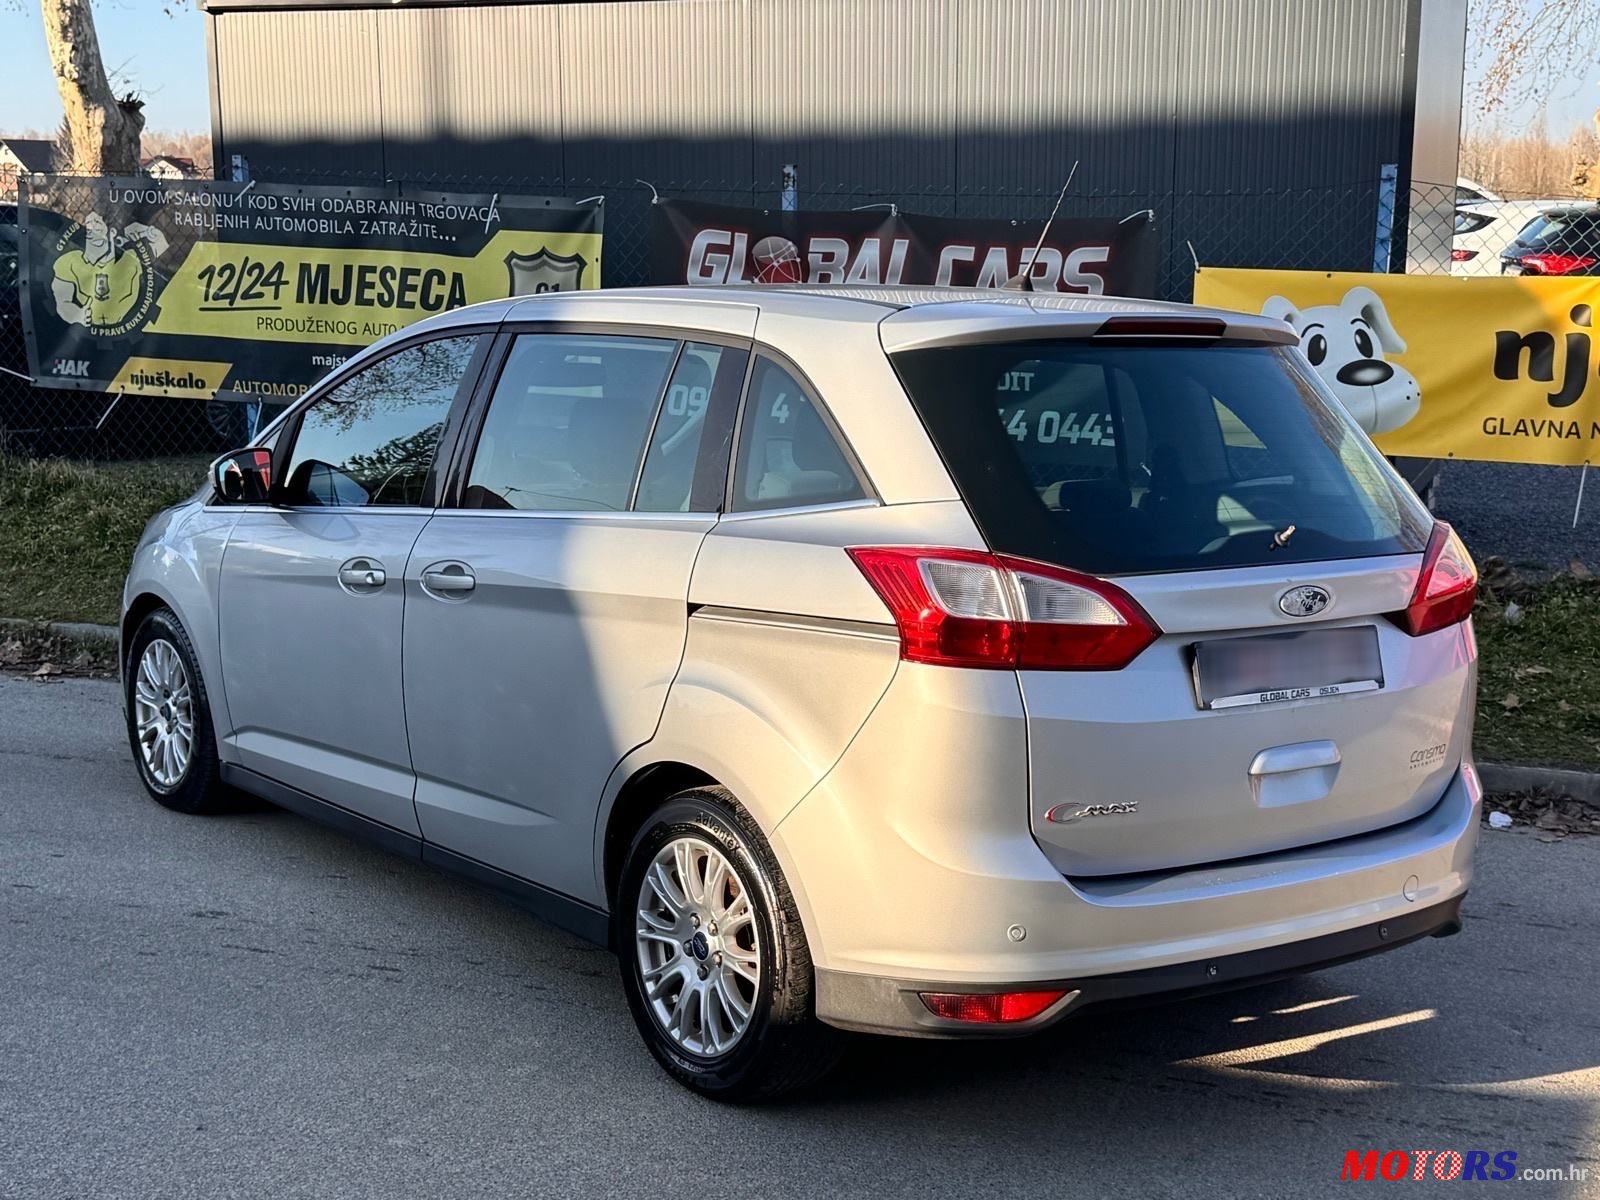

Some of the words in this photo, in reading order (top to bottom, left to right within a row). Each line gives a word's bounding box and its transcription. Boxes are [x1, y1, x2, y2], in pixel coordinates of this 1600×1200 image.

[109, 190, 120, 204] U
[124, 190, 171, 205] OVOM
[175, 191, 234, 208] SALONU
[248, 195, 278, 210] KOD
[282, 196, 316, 212] SVIH
[321, 198, 416, 216] ODABRANIH
[418, 203, 501, 222] TRGOVACA
[174, 212, 249, 230] RABLJENIH
[255, 216, 355, 235] AUTOMOBILA
[360, 219, 457, 242] ZATRAŽITE...
[197, 256, 290, 308] 12/24
[295, 262, 467, 311] MJESECA
[934, 245, 1111, 296] CARS
[257, 316, 358, 335] PRODUŽENOG
[362, 321, 405, 337] AUTO
[1493, 303, 1600, 408] nj
[130, 369, 206, 391] njuškalo
[232, 379, 312, 397] AUTOMOB
[1482, 416, 1582, 440] GLAVNA
[1260, 689, 1289, 703] GLOBAL
[1290, 687, 1311, 699] CARS
